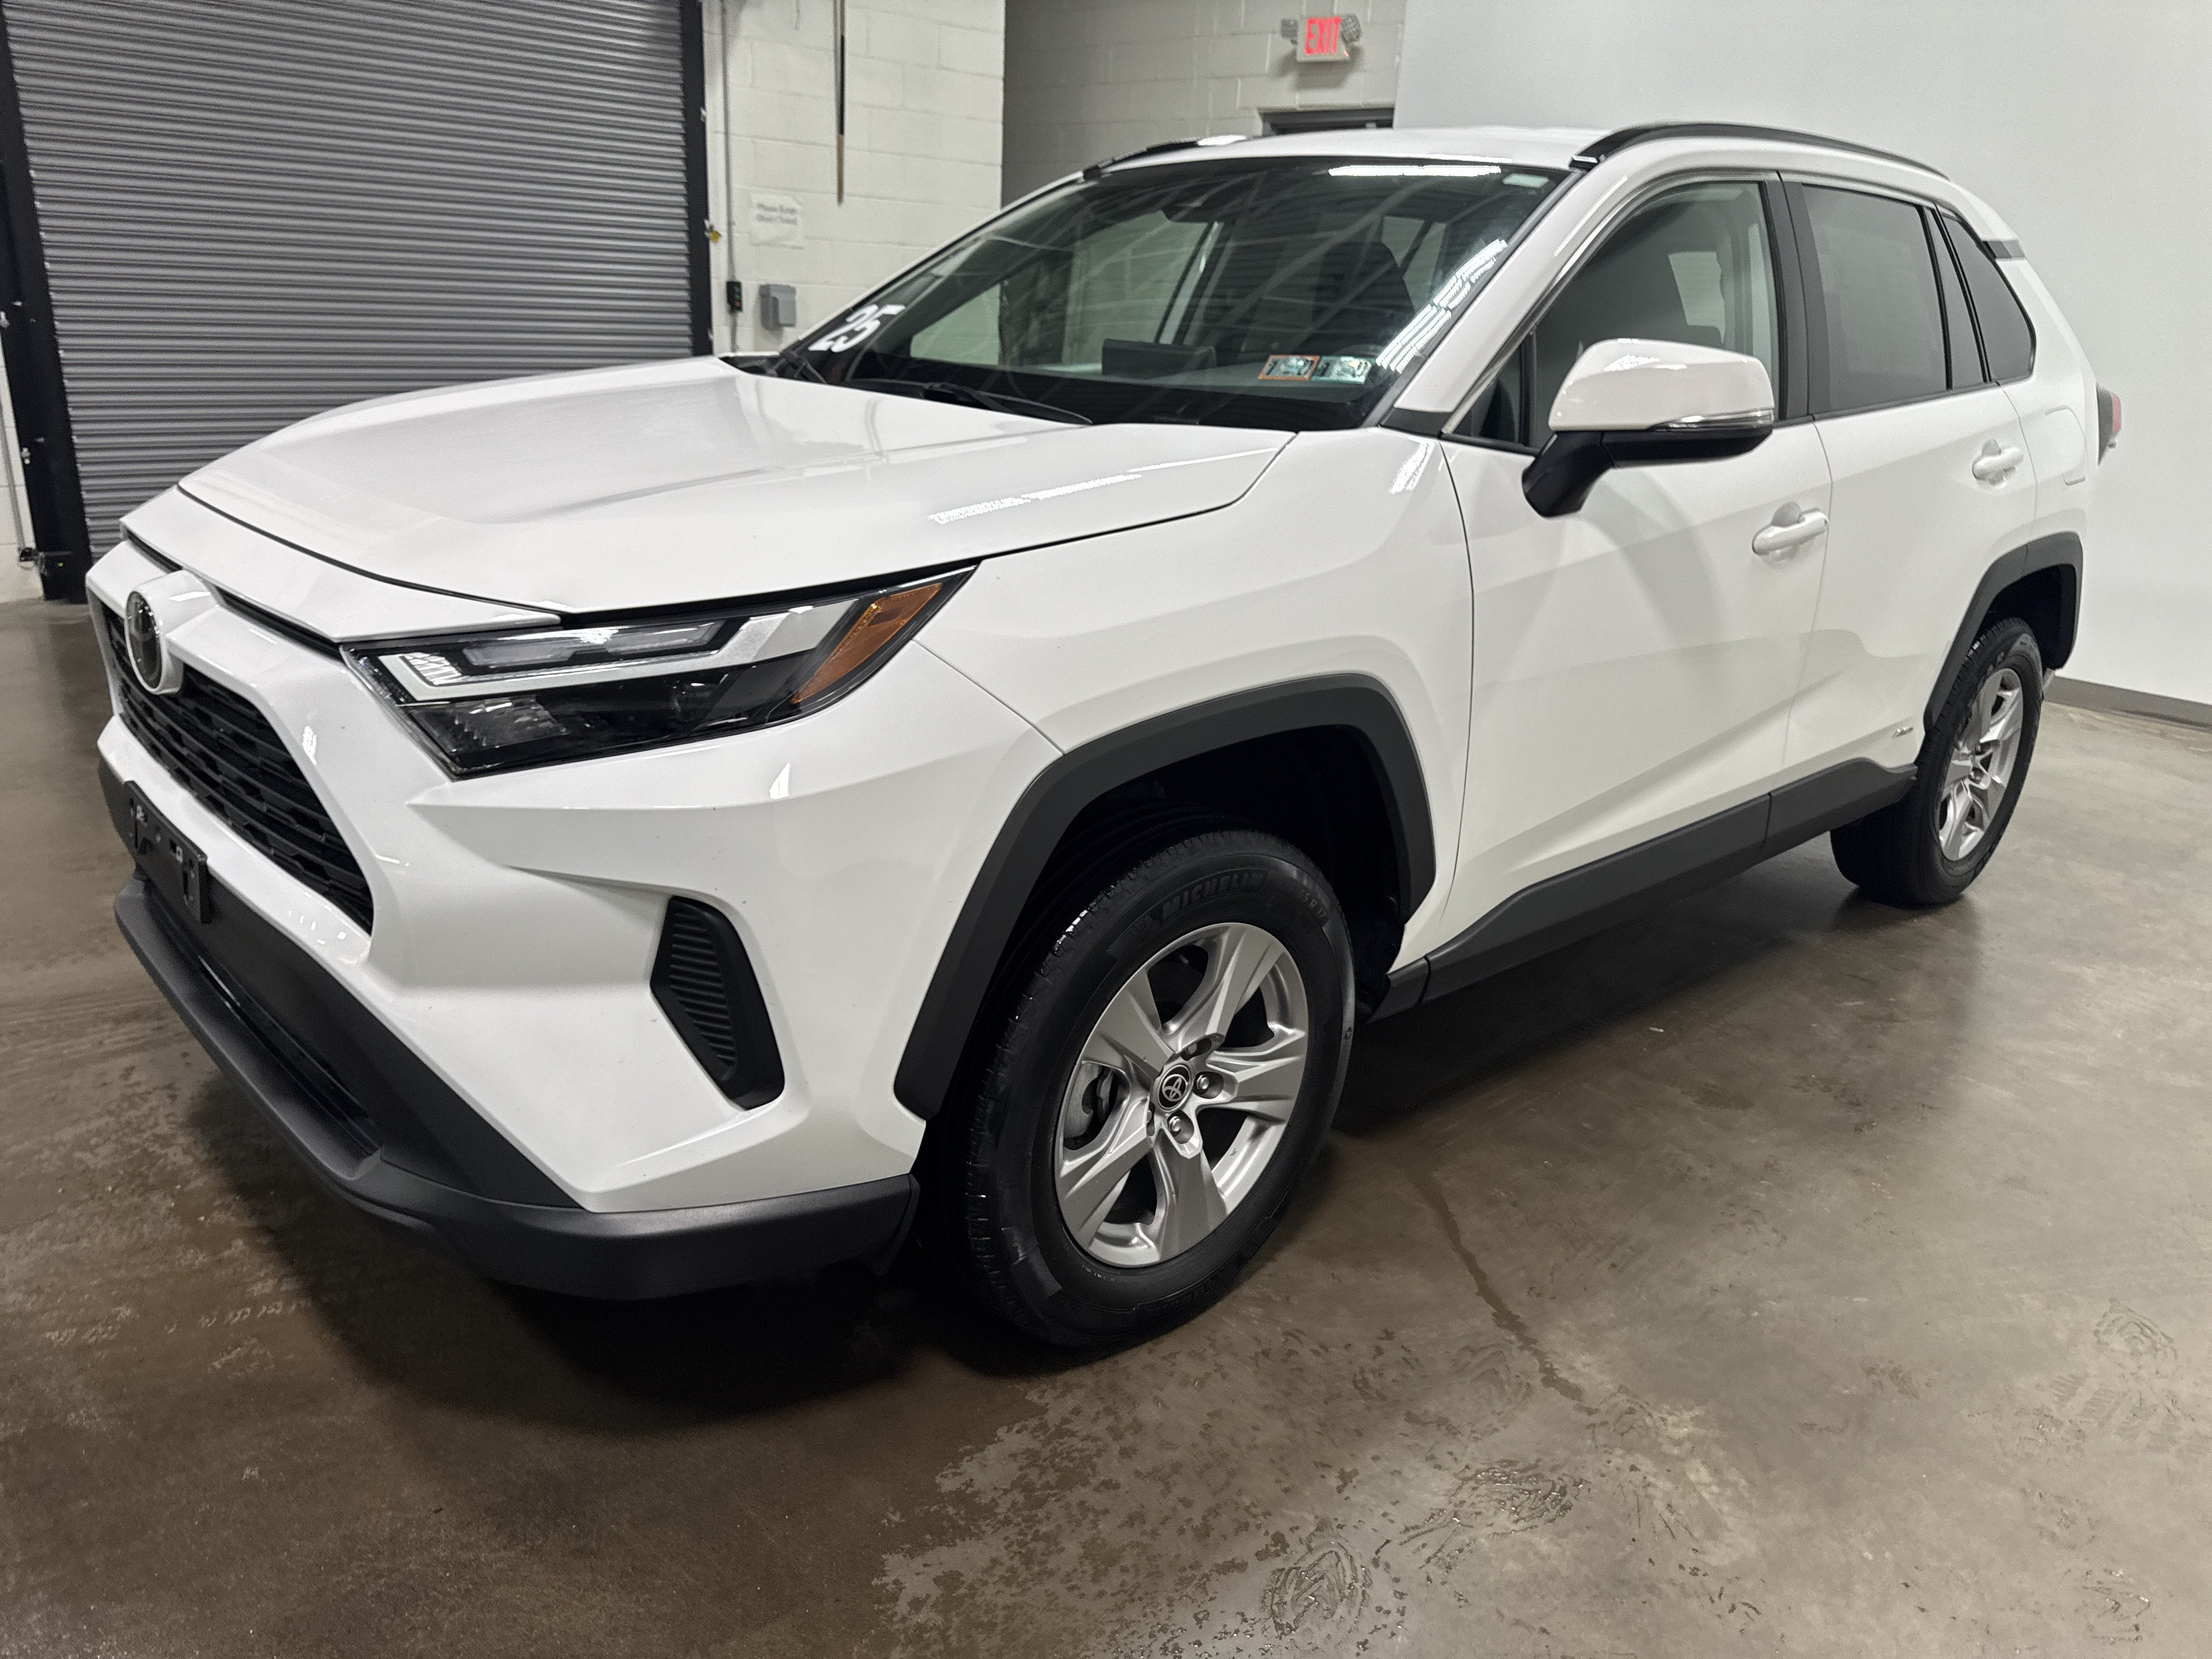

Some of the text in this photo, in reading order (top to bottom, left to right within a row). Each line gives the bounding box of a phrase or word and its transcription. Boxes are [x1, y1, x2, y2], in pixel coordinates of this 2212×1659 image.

[1305, 16, 1341, 55] EXIT
[808, 304, 906, 353] 25
[1163, 873, 1265, 920] MICHELIN
